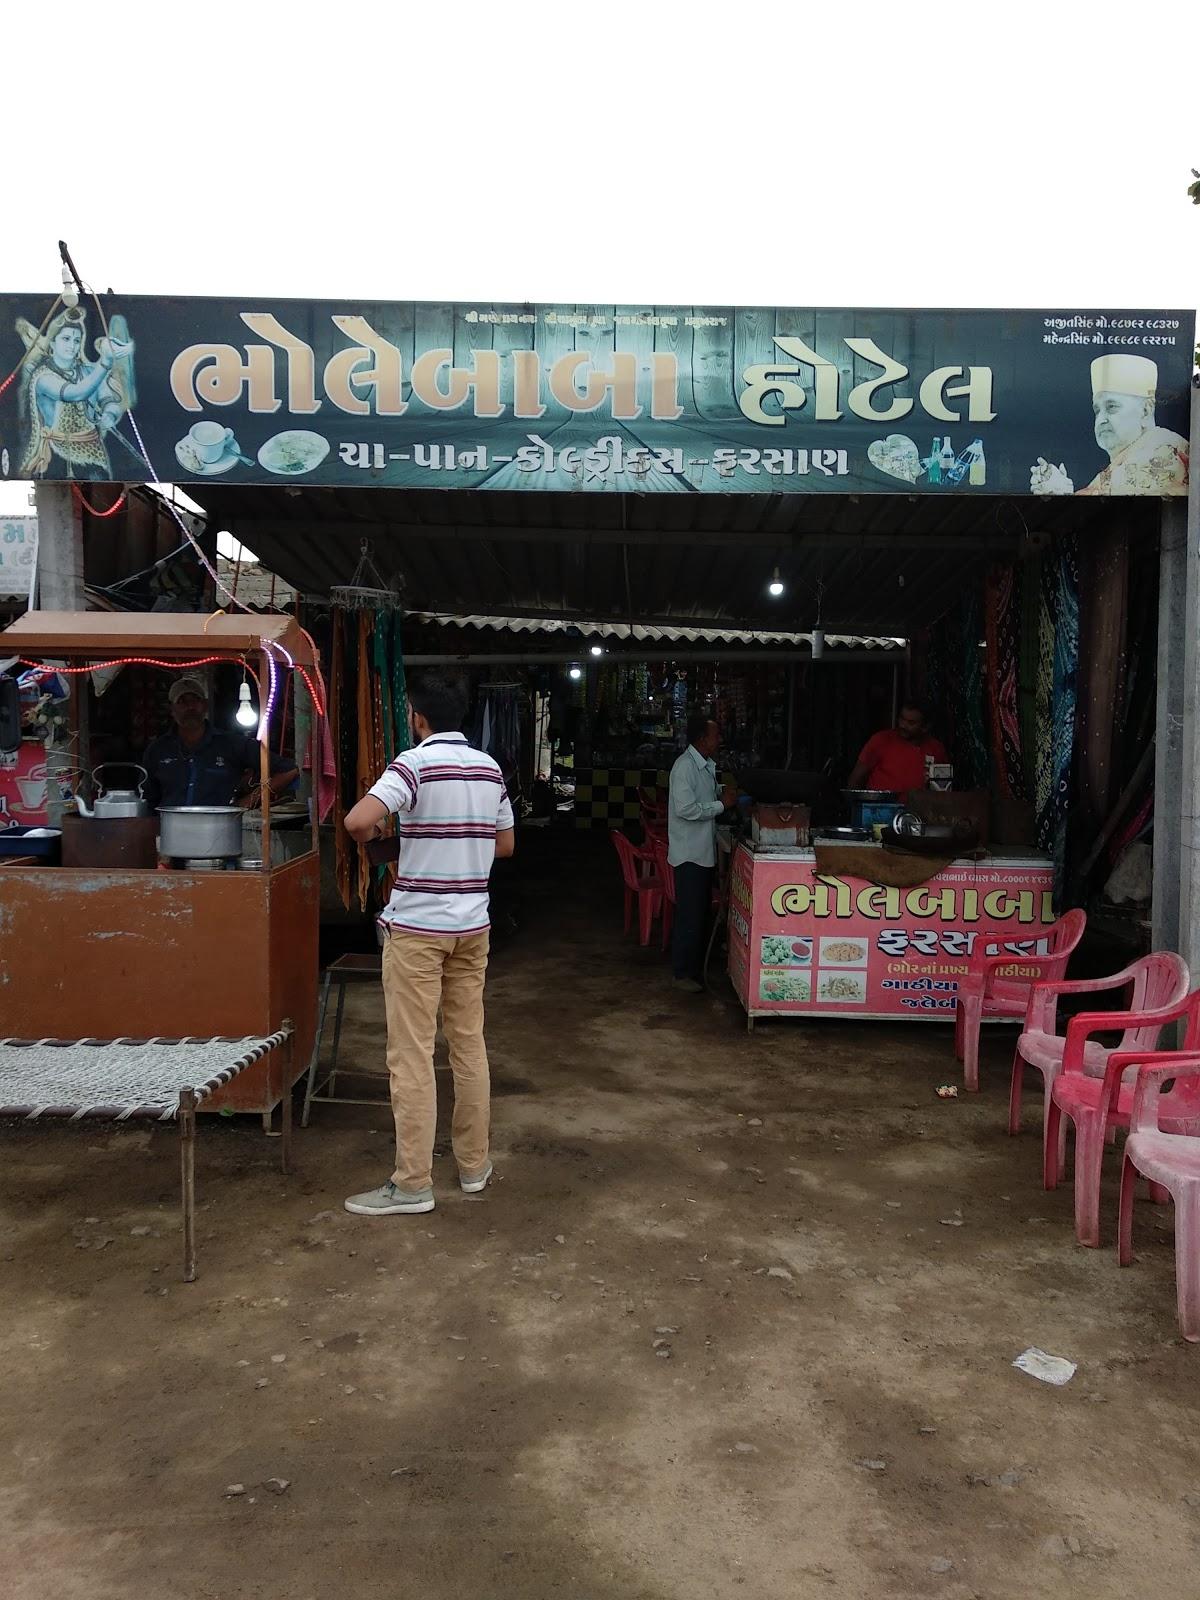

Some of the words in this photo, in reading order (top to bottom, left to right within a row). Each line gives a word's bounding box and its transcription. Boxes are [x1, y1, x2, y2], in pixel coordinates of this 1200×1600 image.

[1044, 316, 1094, 329] અજીતસિંહ
[1146, 318, 1179, 329] ૯૮૩૨૭
[1142, 335, 1176, 345] ૯૨૨૪૫
[169, 312, 684, 419] ભોલેબાબા
[740, 336, 997, 424] હોટેલ
[770, 869, 1056, 924] ભોલબાબા
[901, 994, 958, 1009] જલેબ
